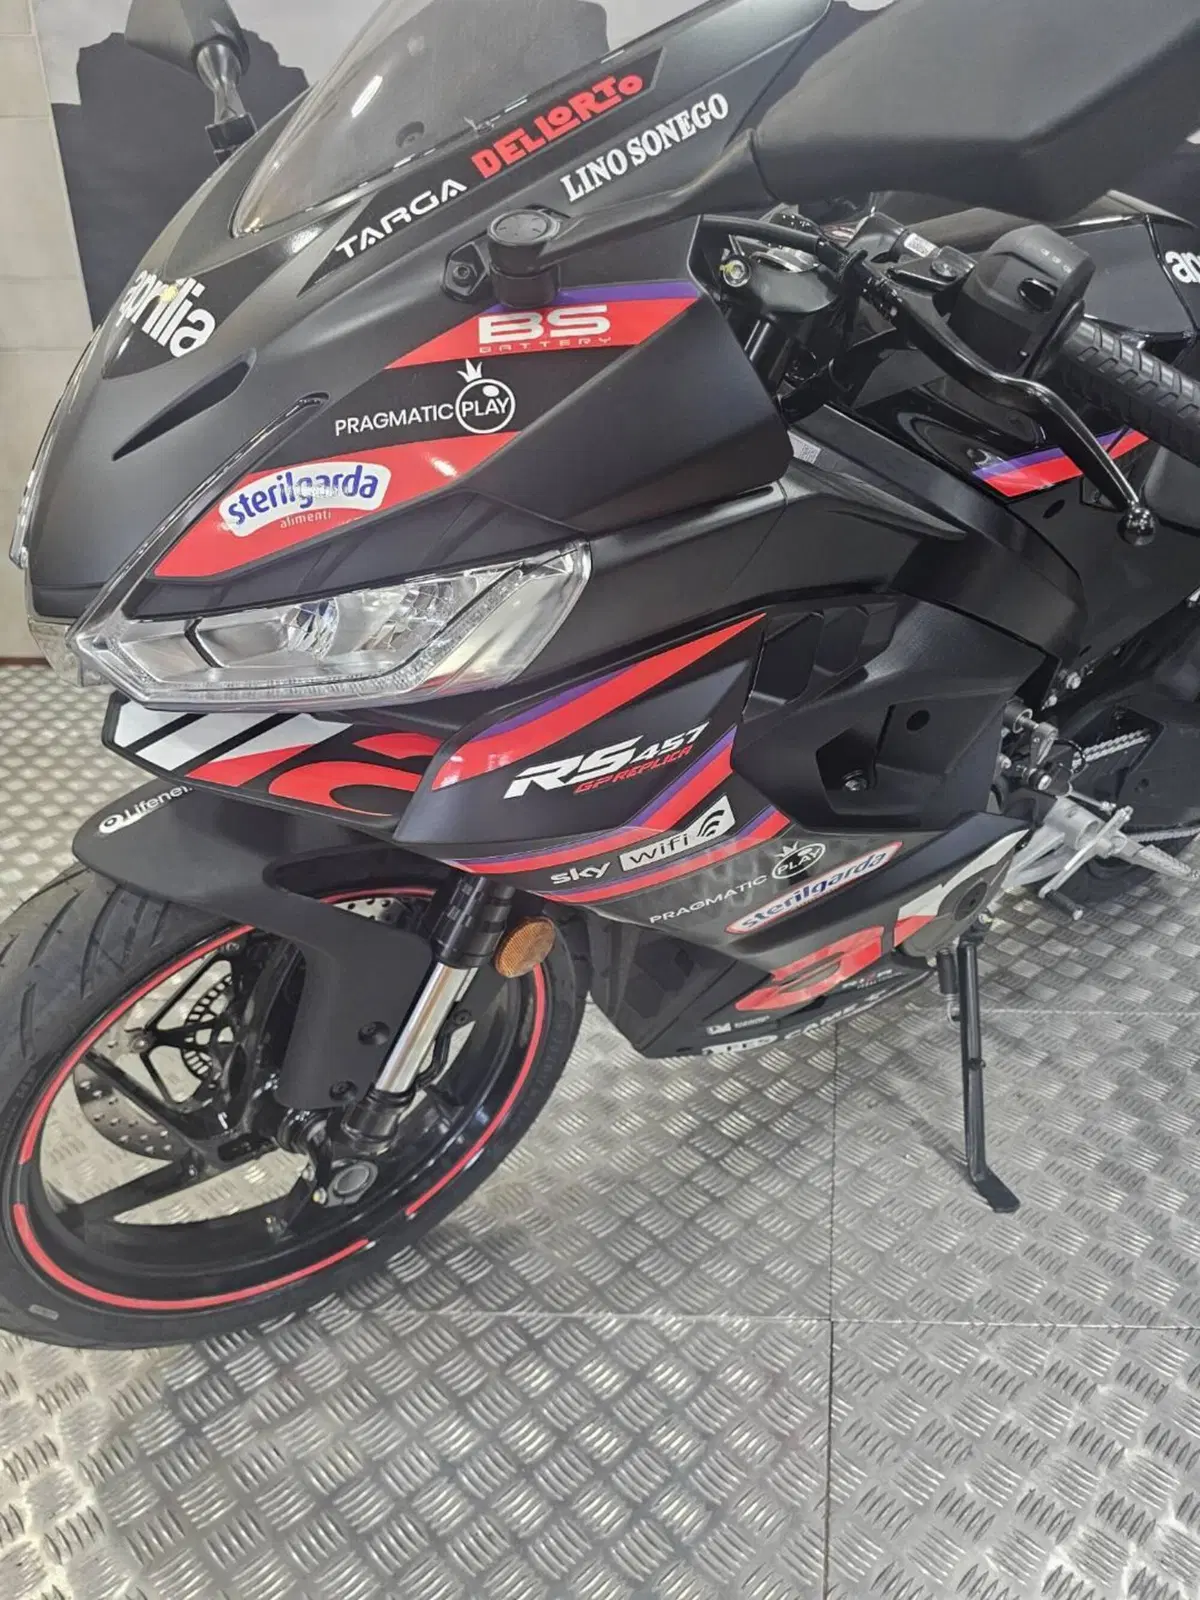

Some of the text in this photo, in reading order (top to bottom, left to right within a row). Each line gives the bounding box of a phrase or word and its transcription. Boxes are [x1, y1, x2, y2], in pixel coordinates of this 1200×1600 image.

[560, 93, 729, 202] LINO SONEGO
[336, 179, 467, 259] TARGA
[479, 305, 611, 344] BS
[479, 337, 611, 353] BATTERY
[335, 397, 511, 436] PRAGMATIC PLAY
[228, 465, 379, 525] sterilgarda
[280, 510, 332, 529] alimenti
[503, 721, 710, 799] RS 457
[551, 861, 610, 885] sky
[649, 847, 822, 924] PRAGMATIC PLAY
[741, 851, 886, 928] sterilgarda
